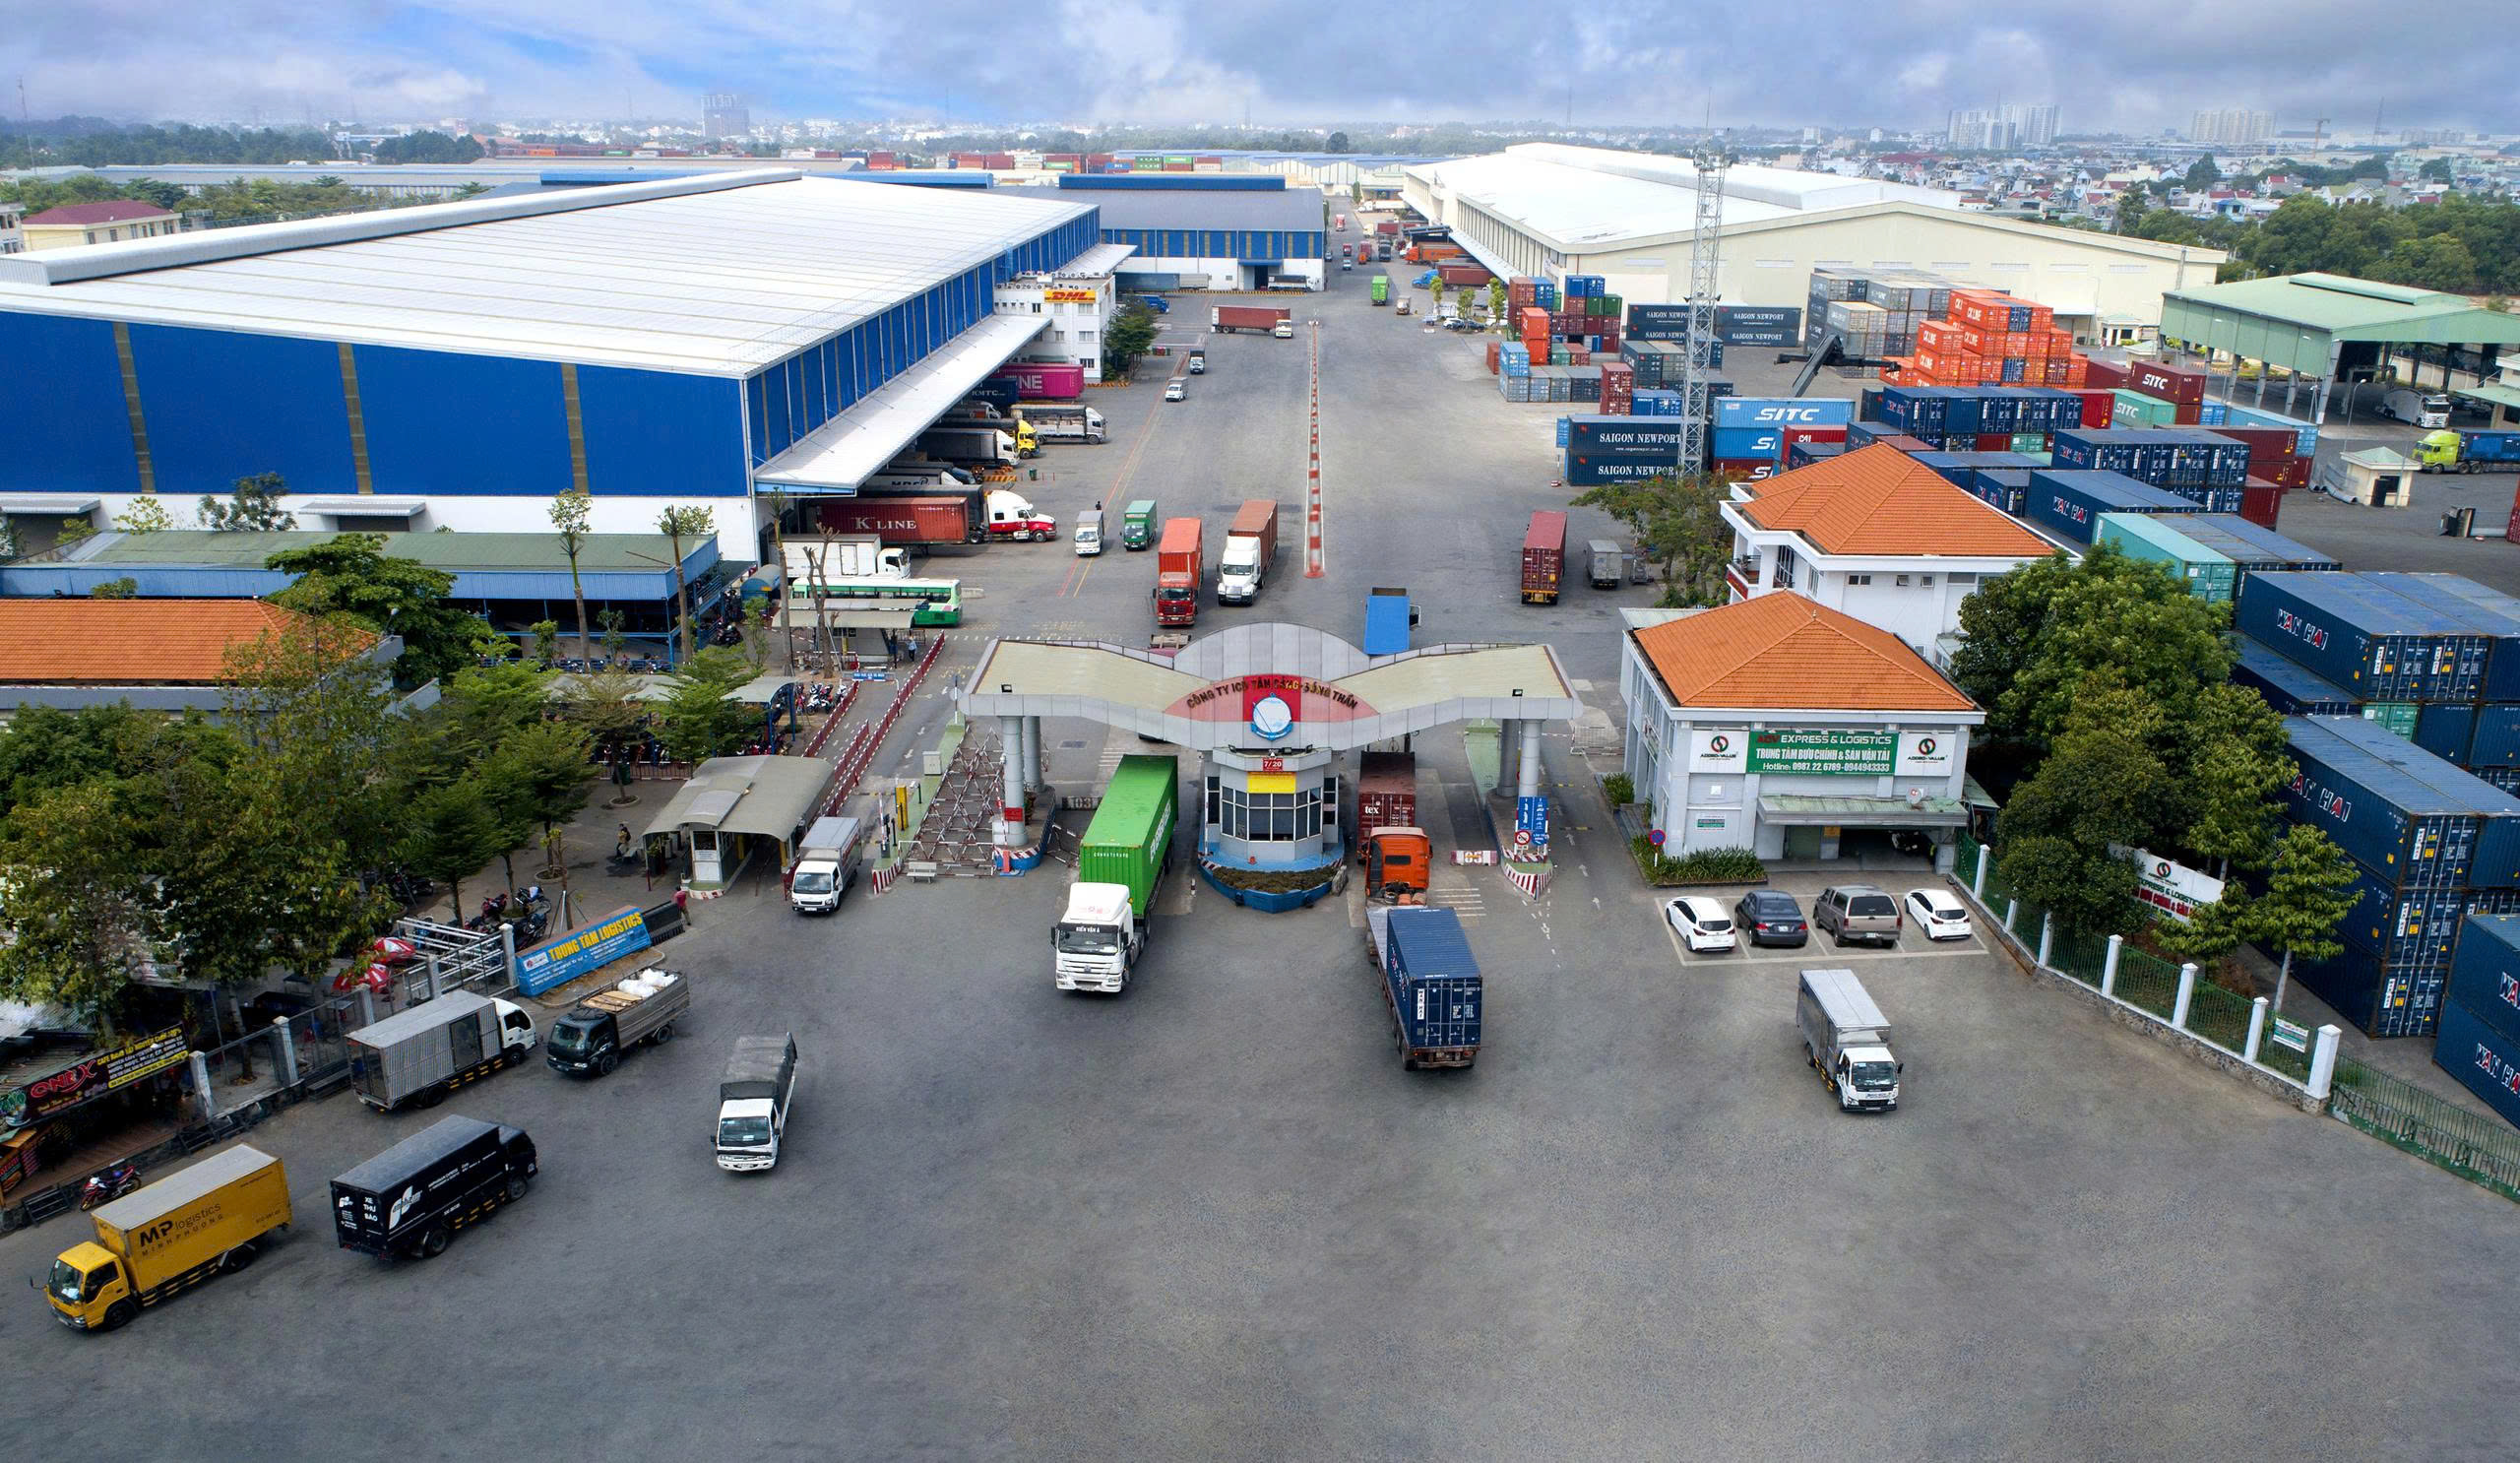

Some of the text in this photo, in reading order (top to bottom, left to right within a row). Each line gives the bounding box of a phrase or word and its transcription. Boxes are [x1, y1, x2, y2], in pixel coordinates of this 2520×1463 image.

[1052, 291, 1088, 300] DHL
[2142, 373, 2169, 390] SITC
[1754, 408, 1820, 421] SITC
[2114, 402, 2139, 418] SITC
[1600, 433, 1681, 444] SAIGON NEWPORT
[1598, 465, 1632, 476] SAIGON
[853, 516, 916, 530] K LINE
[2277, 607, 2329, 651] WAN HAI
[1186, 691, 1216, 709] CÔNG
[1216, 683, 1229, 696] TY
[1781, 734, 1829, 743] EXPRESS
[1840, 736, 1892, 745] LOGISTICS
[1756, 748, 1781, 759] TRUNG
[1781, 746, 1797, 760] TÂM
[1814, 747, 1838, 760] CHÍNH
[1838, 751, 1845, 760] &
[1763, 762, 1792, 771] Hotline:
[1364, 805, 1379, 814] tex
[2318, 788, 2352, 823] HAI
[1465, 851, 1482, 863] 05
[548, 940, 581, 961] TRUNG
[579, 929, 599, 949] TÂM
[598, 912, 643, 940] LOGISTICS
[2476, 1042, 2520, 1099] WAN HA
